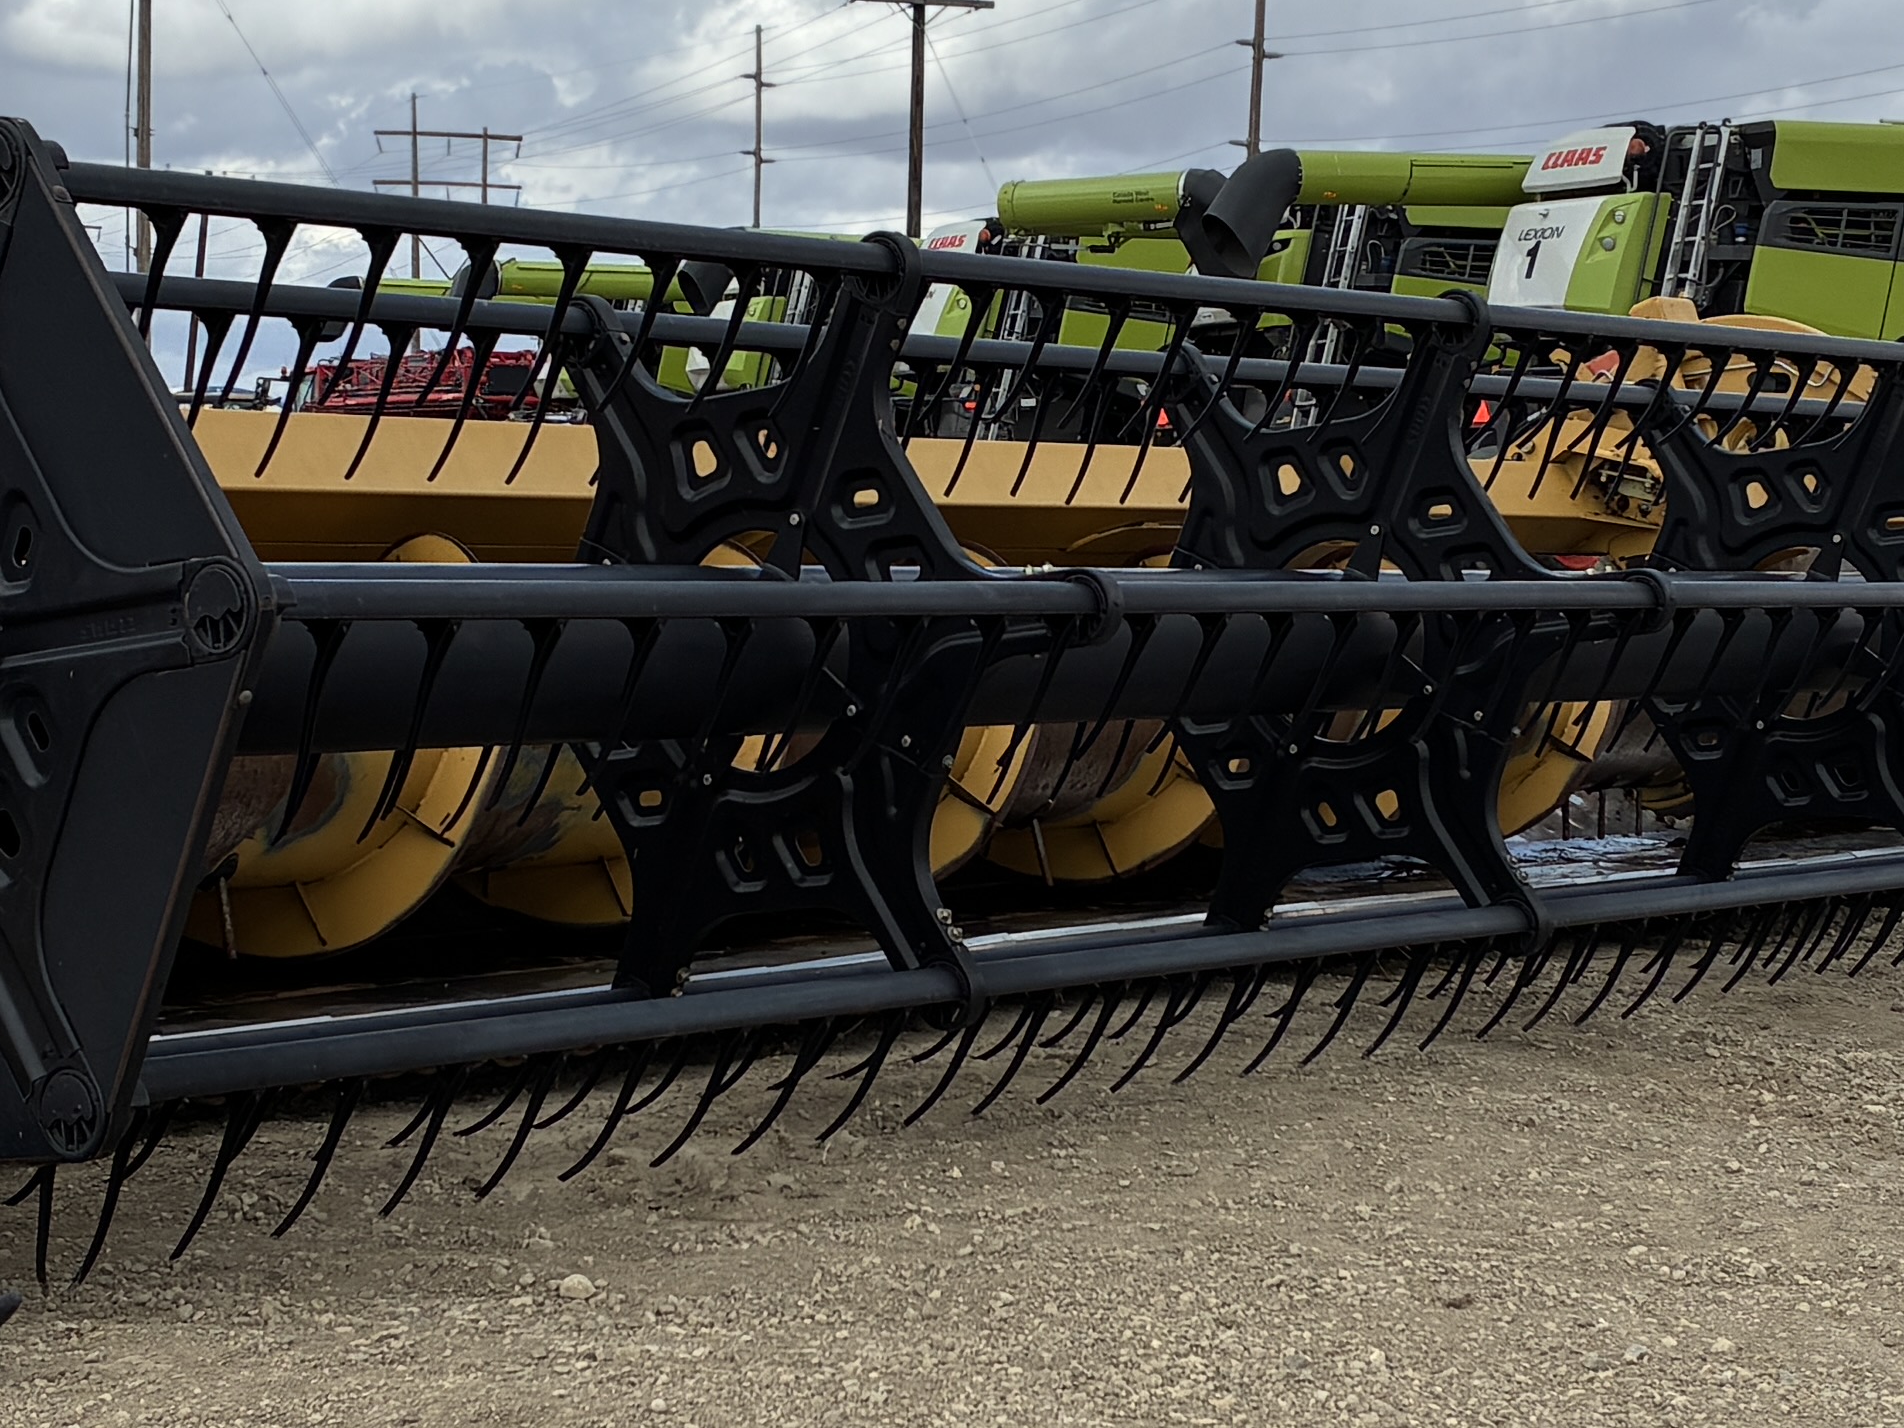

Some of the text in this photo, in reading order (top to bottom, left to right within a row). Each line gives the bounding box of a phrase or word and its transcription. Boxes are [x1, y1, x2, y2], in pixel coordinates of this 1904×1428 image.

[1541, 146, 1607, 170] CLAAS
[1518, 225, 1566, 242] LEXION
[1524, 240, 1542, 280] 1
